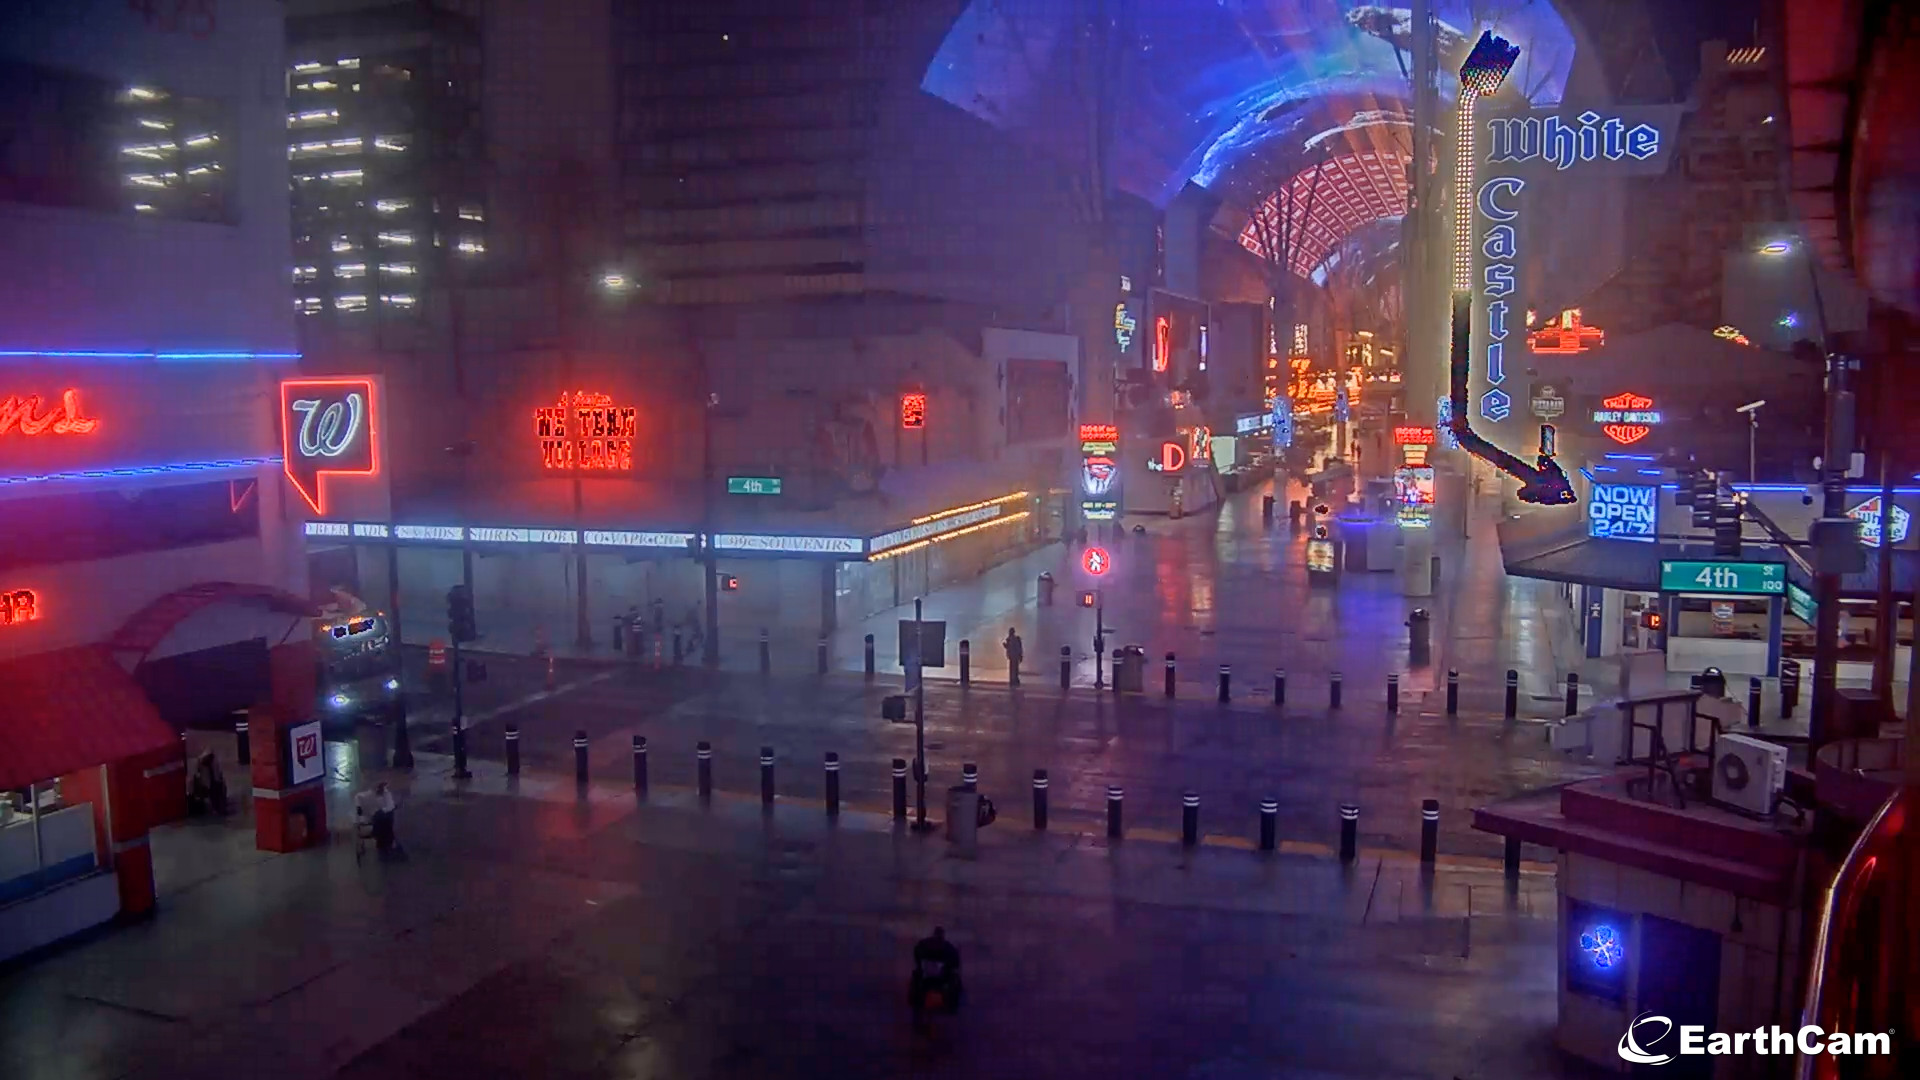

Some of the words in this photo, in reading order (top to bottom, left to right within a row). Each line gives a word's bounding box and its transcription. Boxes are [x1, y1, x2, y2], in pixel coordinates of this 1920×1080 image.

[1486, 111, 1660, 170] White
[1477, 177, 1525, 423] Castle
[536, 407, 638, 437] WETERN
[1147, 457, 1163, 472] the
[1163, 443, 1185, 471] D
[1594, 485, 1651, 505] NOW
[1589, 501, 1655, 523] OPEN
[1594, 519, 1650, 537] 24/7
[759, 536, 853, 552] SOUVENIRS
[1695, 566, 1739, 589] 4th
[1762, 579, 1784, 591] 100
